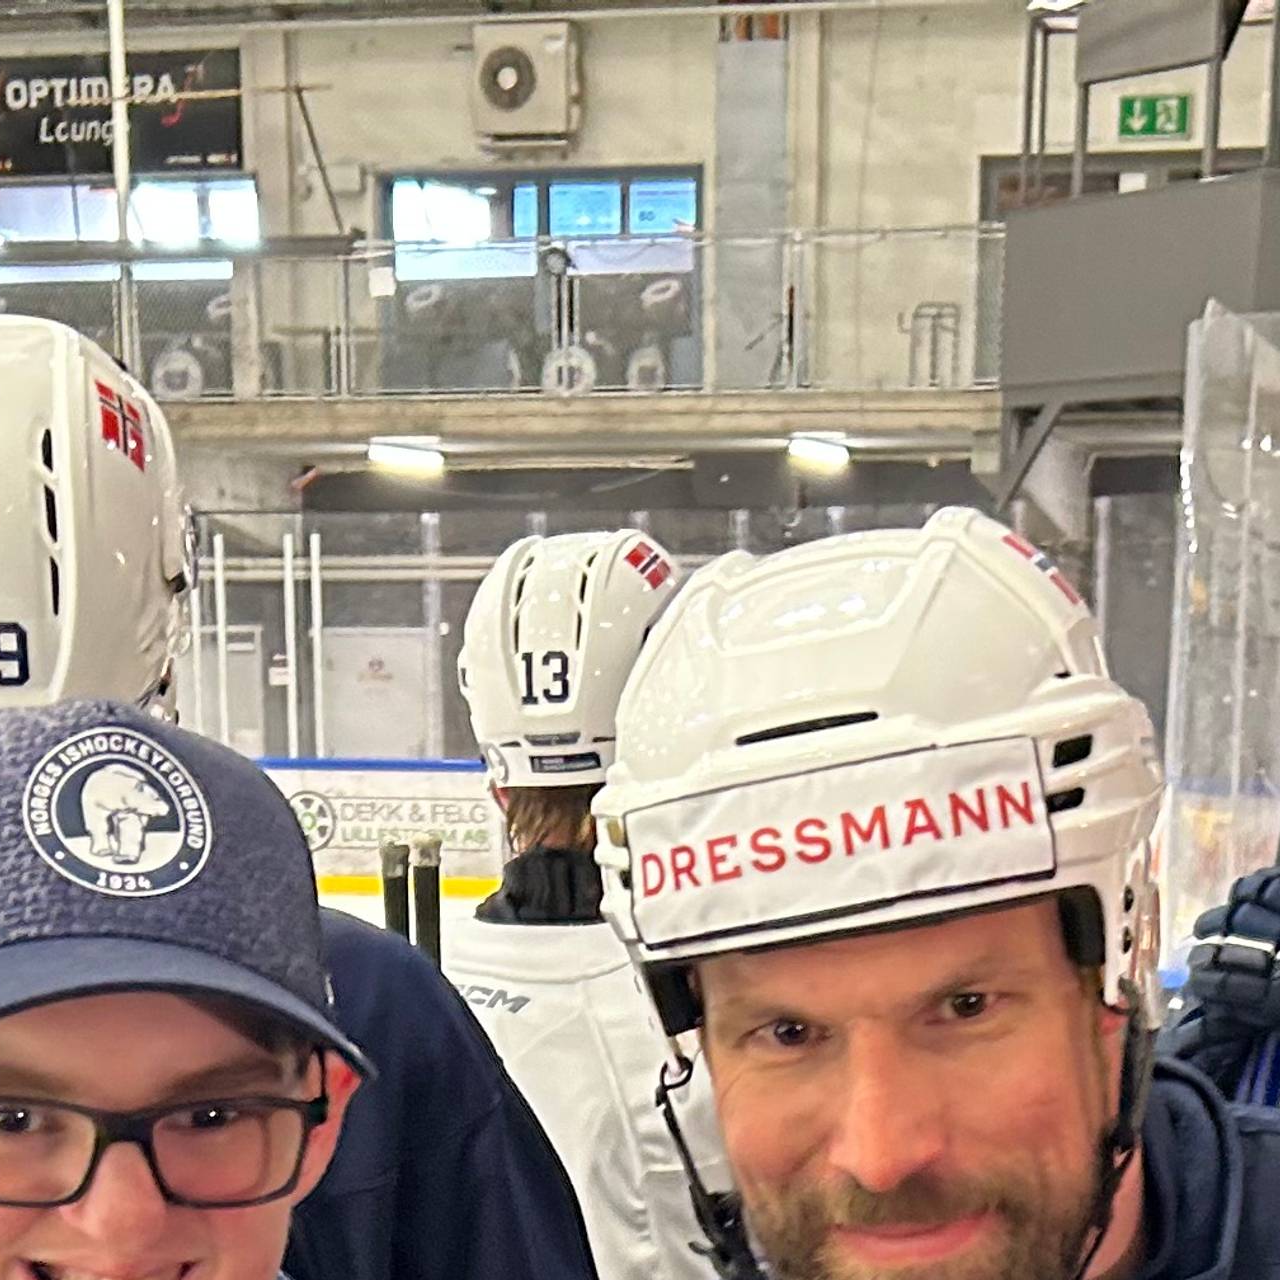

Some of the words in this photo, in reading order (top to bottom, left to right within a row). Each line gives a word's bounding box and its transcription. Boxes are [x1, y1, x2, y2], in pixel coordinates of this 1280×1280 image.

[5, 73, 178, 111] OPTIMRA
[39, 116, 129, 146] Loung
[521, 651, 569, 705] 13
[29, 761, 64, 836] NORGES
[58, 735, 205, 850] ISHOCKEYFORBUND
[341, 802, 404, 822] DEKK
[409, 803, 425, 823] &
[641, 782, 1035, 898] DRESSMANN
[96, 871, 153, 892] 1934
[458, 985, 531, 1014] CM
